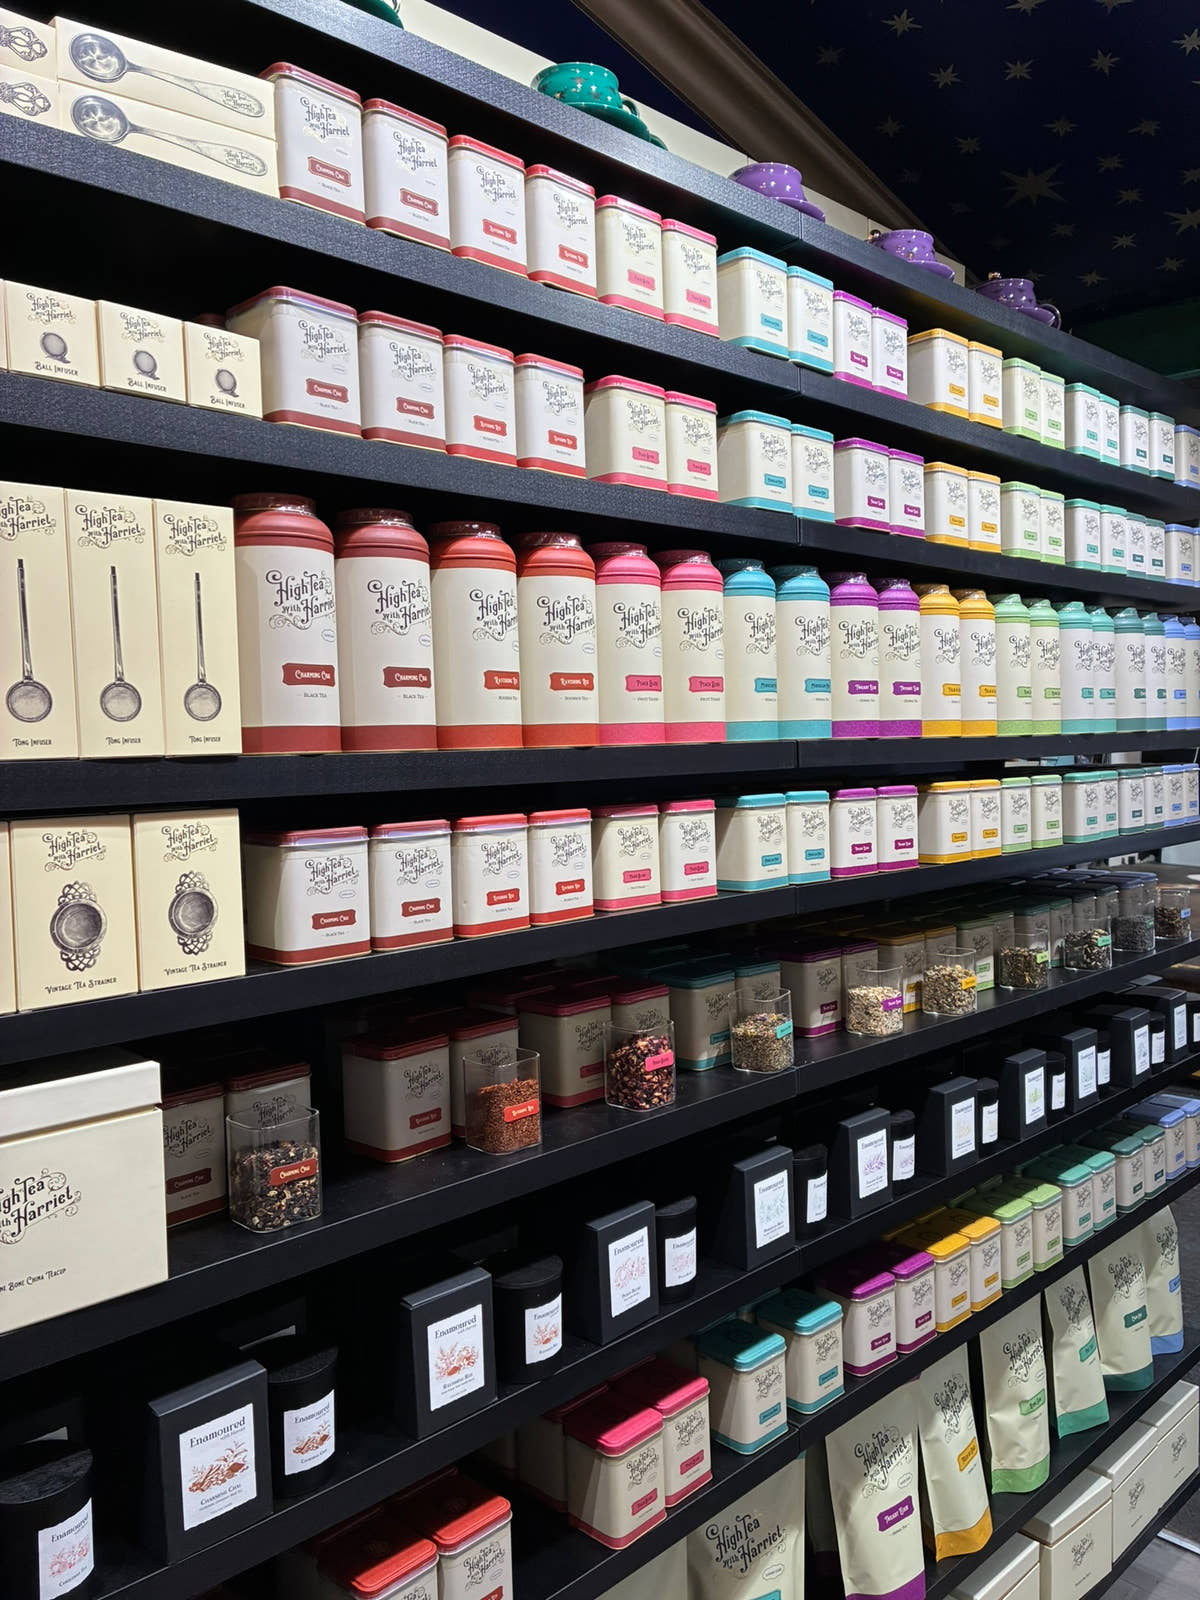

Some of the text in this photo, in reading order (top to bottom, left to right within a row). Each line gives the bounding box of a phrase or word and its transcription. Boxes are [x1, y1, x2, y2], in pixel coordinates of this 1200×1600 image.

[300, 97, 336, 122] High Tea
[393, 132, 425, 155] High Tea
[26, 292, 60, 312] High Tea
[120, 312, 151, 330] High Tea
[298, 320, 334, 344] High Tea
[204, 332, 232, 350] High Tea
[390, 342, 422, 365] High Tea
[9, 496, 31, 516] Tea
[75, 504, 123, 532] High Tea
[6, 514, 51, 536] Harriet
[88, 524, 141, 546] with Harriet
[163, 514, 207, 540] High Tea
[186, 533, 222, 553] Harriet
[266, 570, 324, 606] High Tea
[368, 580, 420, 614] High Tea
[282, 604, 300, 616] with
[382, 612, 400, 622] with
[470, 589, 514, 621] High Tea
[537, 596, 584, 626] High Tea
[614, 602, 656, 630] High Tea
[484, 620, 498, 630] with
[550, 624, 564, 634] with
[678, 608, 717, 634] High Tea
[744, 612, 769, 638] High
[795, 616, 819, 640] High
[839, 620, 865, 644] High
[625, 629, 639, 638] with
[689, 632, 702, 641] with
[884, 625, 908, 648] High
[42, 831, 86, 858] High Tea
[162, 824, 200, 850] High Tea
[182, 835, 214, 857] Harriet
[550, 837, 568, 858] High
[66, 843, 102, 866] Harriet
[395, 849, 428, 872] High Tea
[481, 842, 500, 864] High
[305, 856, 342, 882] High Tea
[14, 1176, 44, 1203] Tea
[10, 1186, 72, 1238] Harriet
[434, 1315, 477, 1339] Enamoured
[294, 1402, 330, 1424] Enamoured
[189, 1416, 246, 1449] Enamoured
[854, 1431, 890, 1478] High Tea
[51, 1513, 89, 1544] Enamoured
[706, 1514, 760, 1562] High Tea
[722, 1554, 740, 1569] with
[738, 1524, 783, 1574] Harriet
